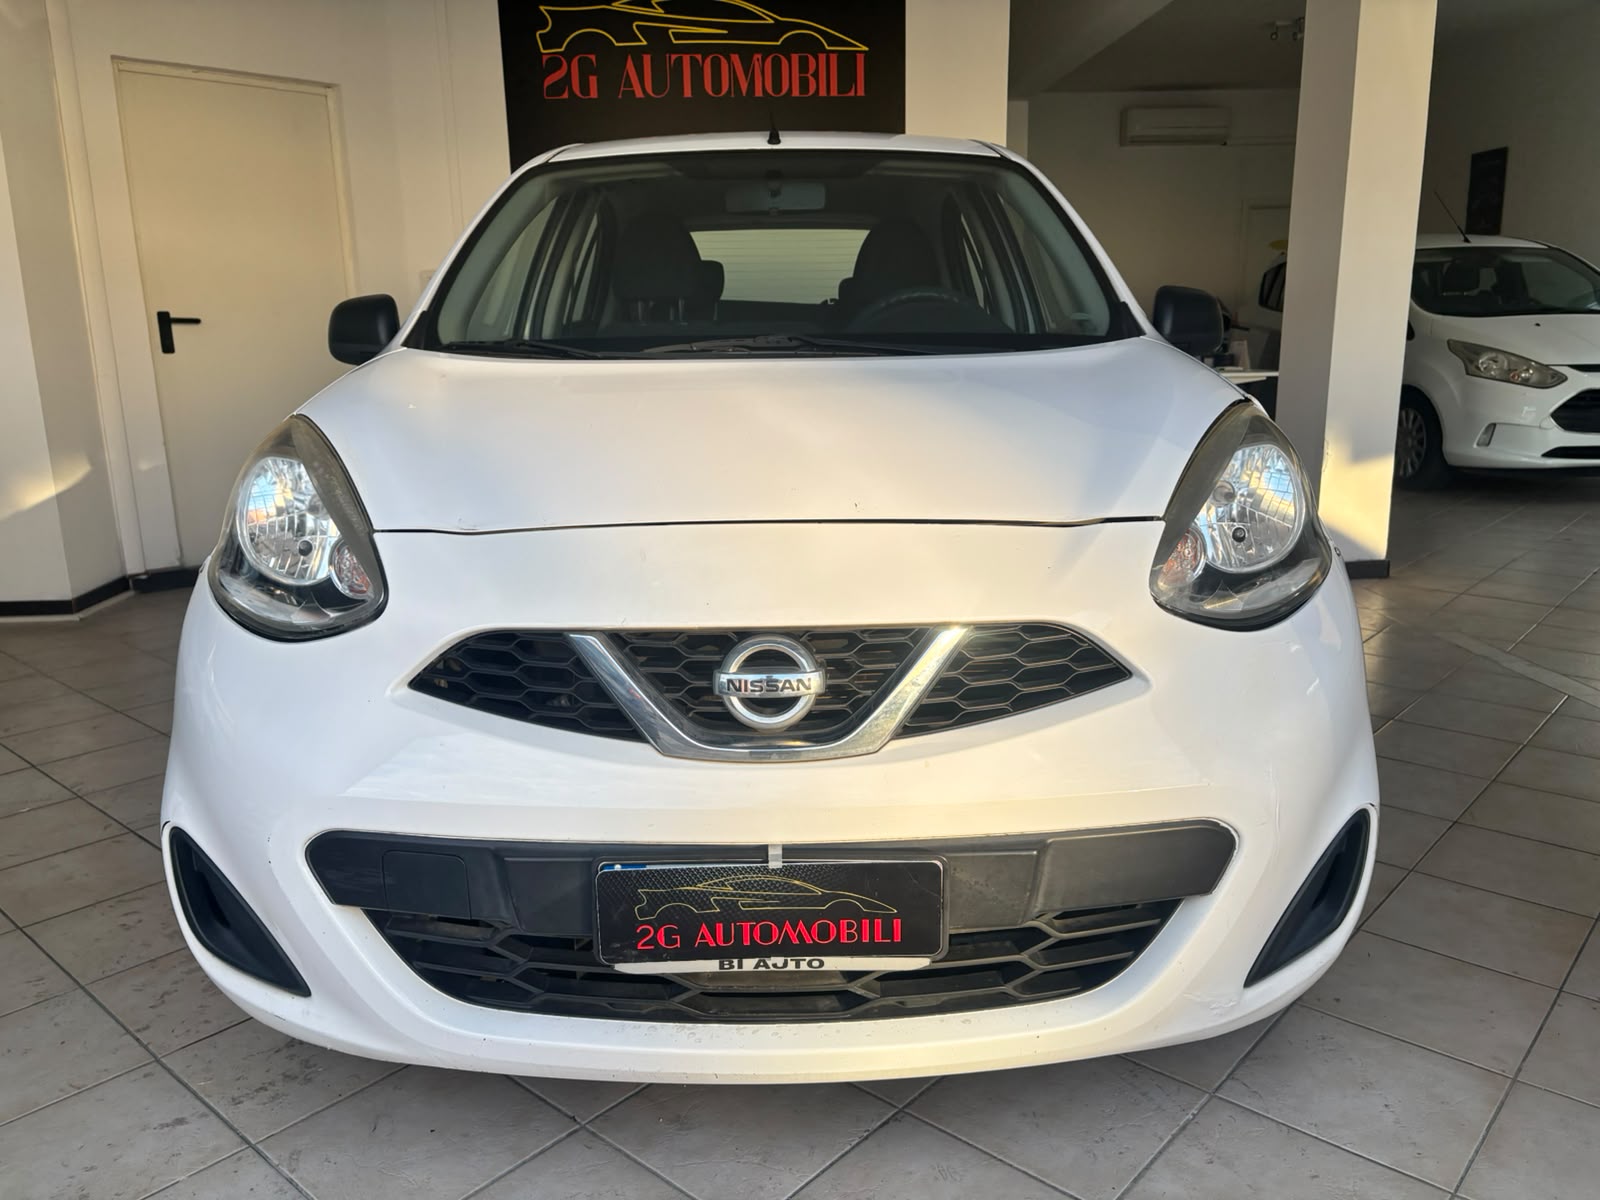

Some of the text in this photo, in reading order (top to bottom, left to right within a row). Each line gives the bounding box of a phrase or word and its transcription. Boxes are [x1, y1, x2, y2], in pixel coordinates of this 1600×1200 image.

[542, 52, 866, 99] 2G AUTOMOBILI
[726, 677, 812, 693] NISSAN
[635, 917, 902, 950] 2G AUTOMOBILI
